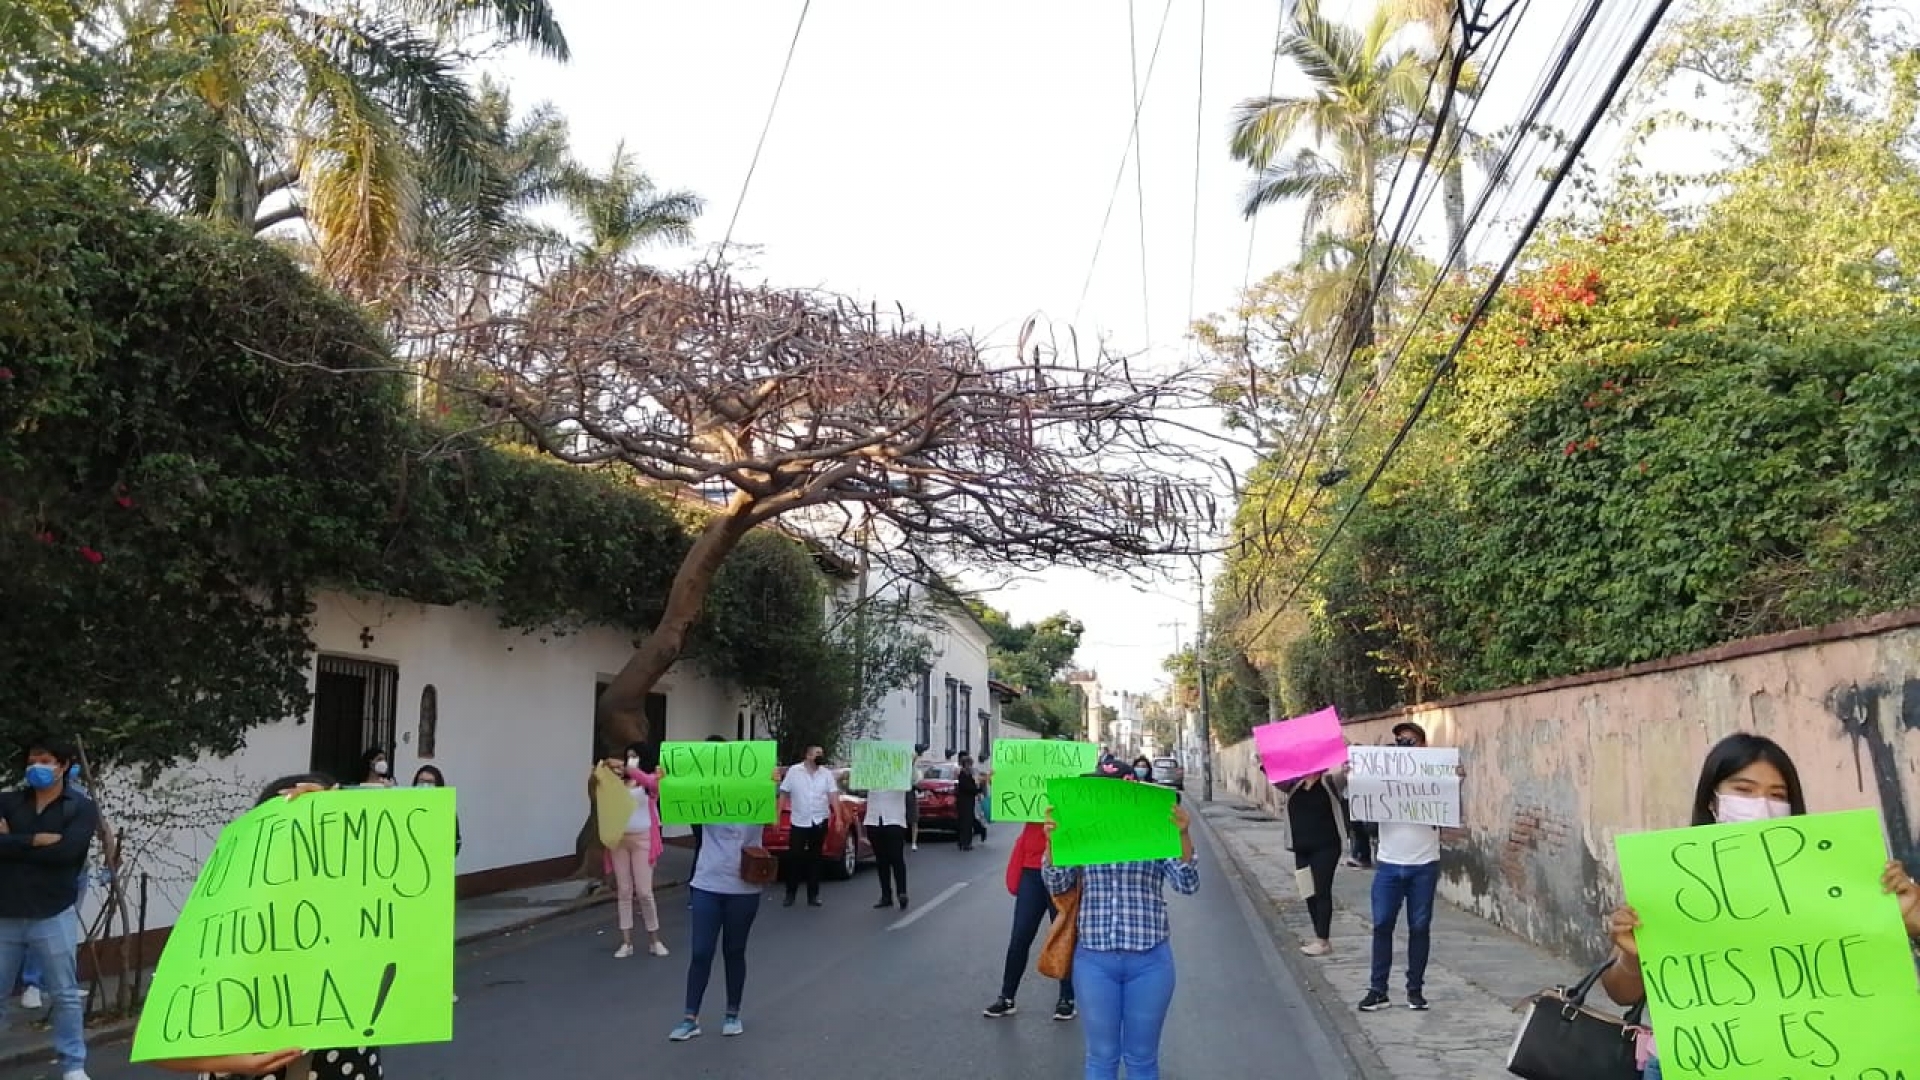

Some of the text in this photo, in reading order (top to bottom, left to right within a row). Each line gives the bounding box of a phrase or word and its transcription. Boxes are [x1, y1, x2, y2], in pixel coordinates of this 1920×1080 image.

[1043, 743, 1082, 768] PASA
[700, 784, 720, 798] MI
[1398, 800, 1450, 824] MIENTE
[249, 801, 430, 897] TENEMOS
[1671, 826, 1842, 923] SEP:
[360, 897, 394, 940] NI
[1770, 934, 1875, 1000] DICE
[1674, 1011, 1839, 1077] QUE ES
